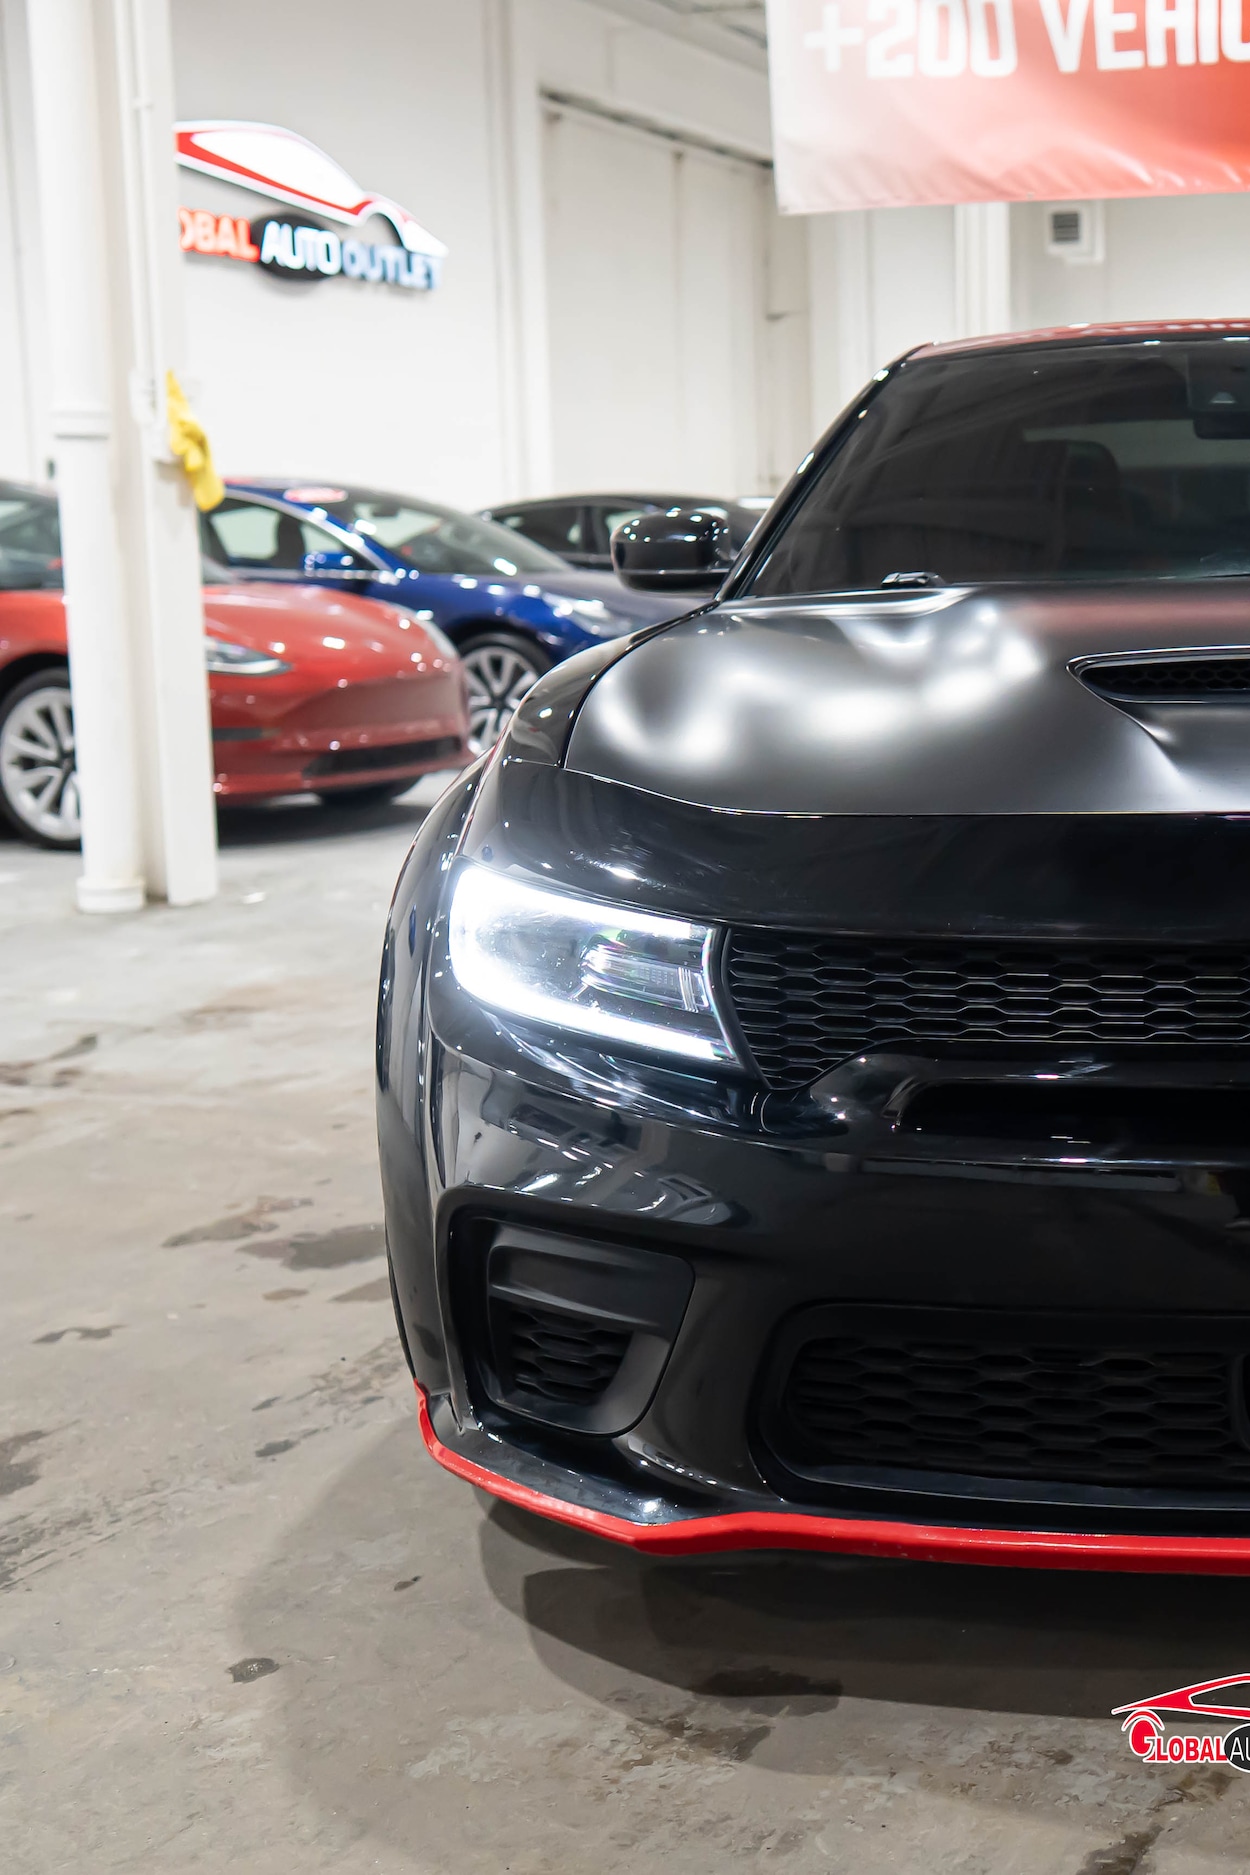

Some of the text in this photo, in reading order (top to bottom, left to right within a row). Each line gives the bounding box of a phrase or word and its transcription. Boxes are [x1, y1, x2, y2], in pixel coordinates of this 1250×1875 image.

[803, 0, 1019, 78] +200
[260, 219, 341, 276] AUTO
[341, 240, 441, 290] OUTLET
